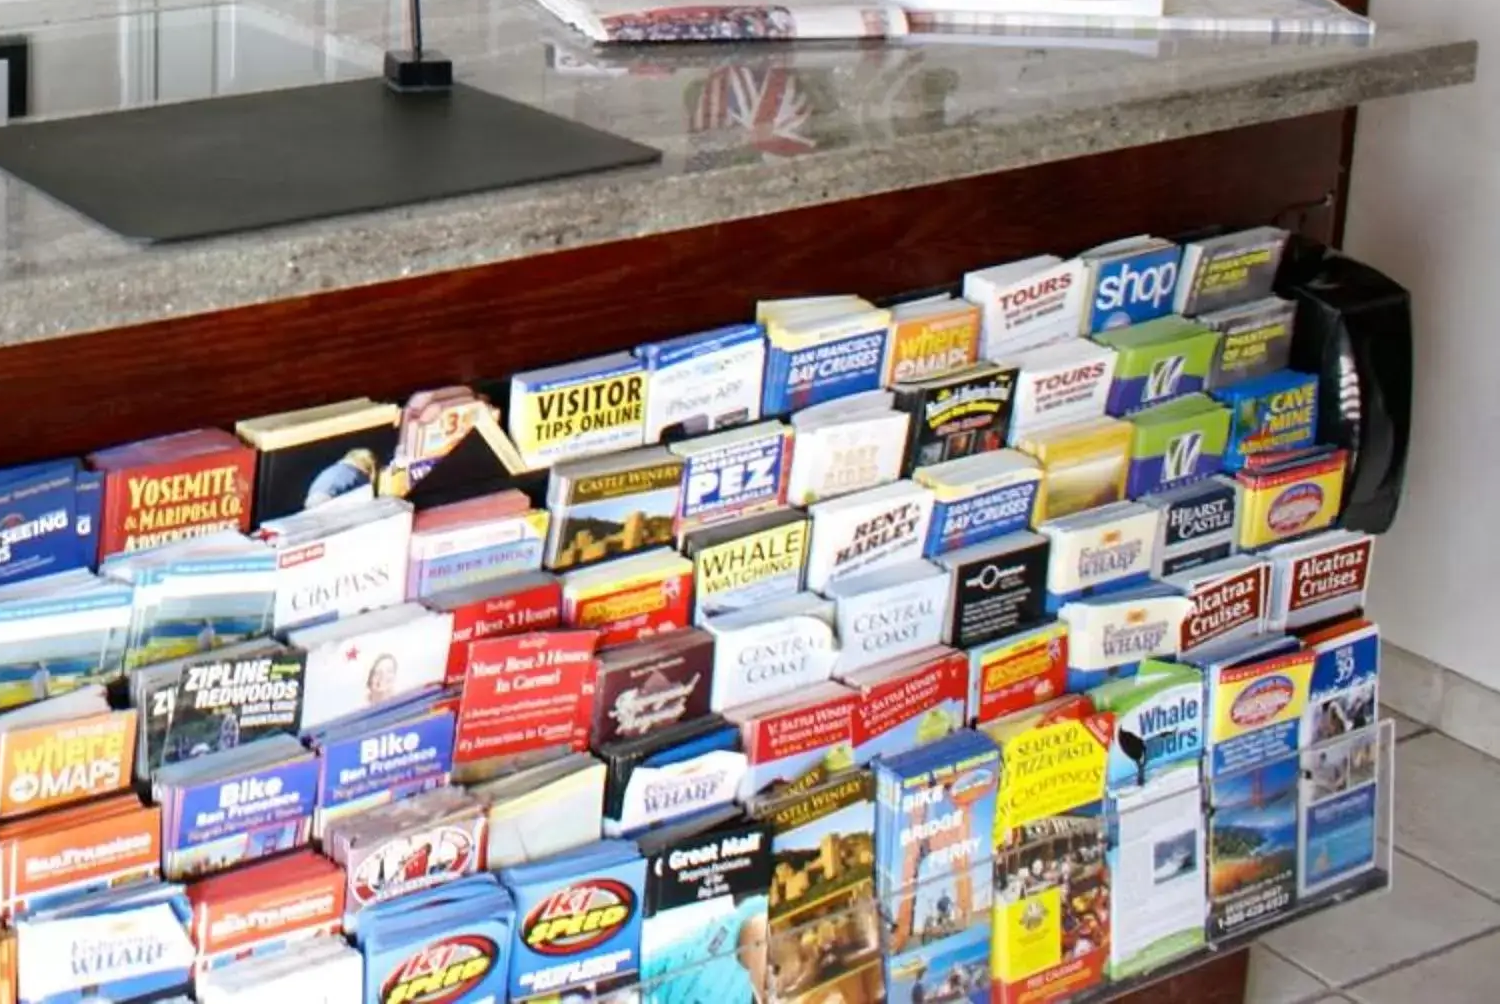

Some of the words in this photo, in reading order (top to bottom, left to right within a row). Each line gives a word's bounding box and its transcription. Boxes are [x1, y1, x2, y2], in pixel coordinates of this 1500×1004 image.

[999, 271, 1072, 310] TOURS
[1095, 261, 1178, 311] shop
[1033, 361, 1107, 394] TOURS
[536, 374, 643, 421] VISITOR
[534, 415, 573, 443] TIPS
[579, 402, 642, 433] ONLINE
[127, 465, 240, 510] YOSEMITE
[687, 456, 778, 506] PEZ
[139, 500, 218, 533] MARIPOSA
[853, 502, 913, 541] RENT
[1171, 499, 1227, 527] HEARST
[1178, 509, 1233, 539] CASTLE
[702, 527, 803, 578] WHALE
[835, 516, 920, 566] HARLEY
[704, 557, 795, 594] WATCHING
[1298, 546, 1364, 581] Alcatraz
[1186, 574, 1256, 619] Alcatraz
[1300, 567, 1358, 598] Cruises
[853, 597, 935, 634] CENTRAL
[1190, 602, 1251, 636] Cruises
[861, 625, 921, 652] COAST
[184, 659, 272, 692] ZIPLINE
[746, 656, 809, 685] COAST
[195, 679, 299, 710] REDWOODS
[1138, 697, 1199, 736] Whale
[13, 730, 126, 775] where
[339, 767, 367, 785] San
[369, 747, 438, 773] Francisco
[359, 731, 420, 765] Bike
[38, 758, 122, 801] MAPS
[218, 776, 284, 808] Bike
[195, 808, 225, 827] San
[228, 792, 300, 817] Francisco
[668, 842, 719, 871] Great
[720, 831, 763, 858] Mall
[527, 903, 629, 946] SPEED
[70, 942, 169, 976] WHARF
[387, 955, 491, 1004] SPEED
